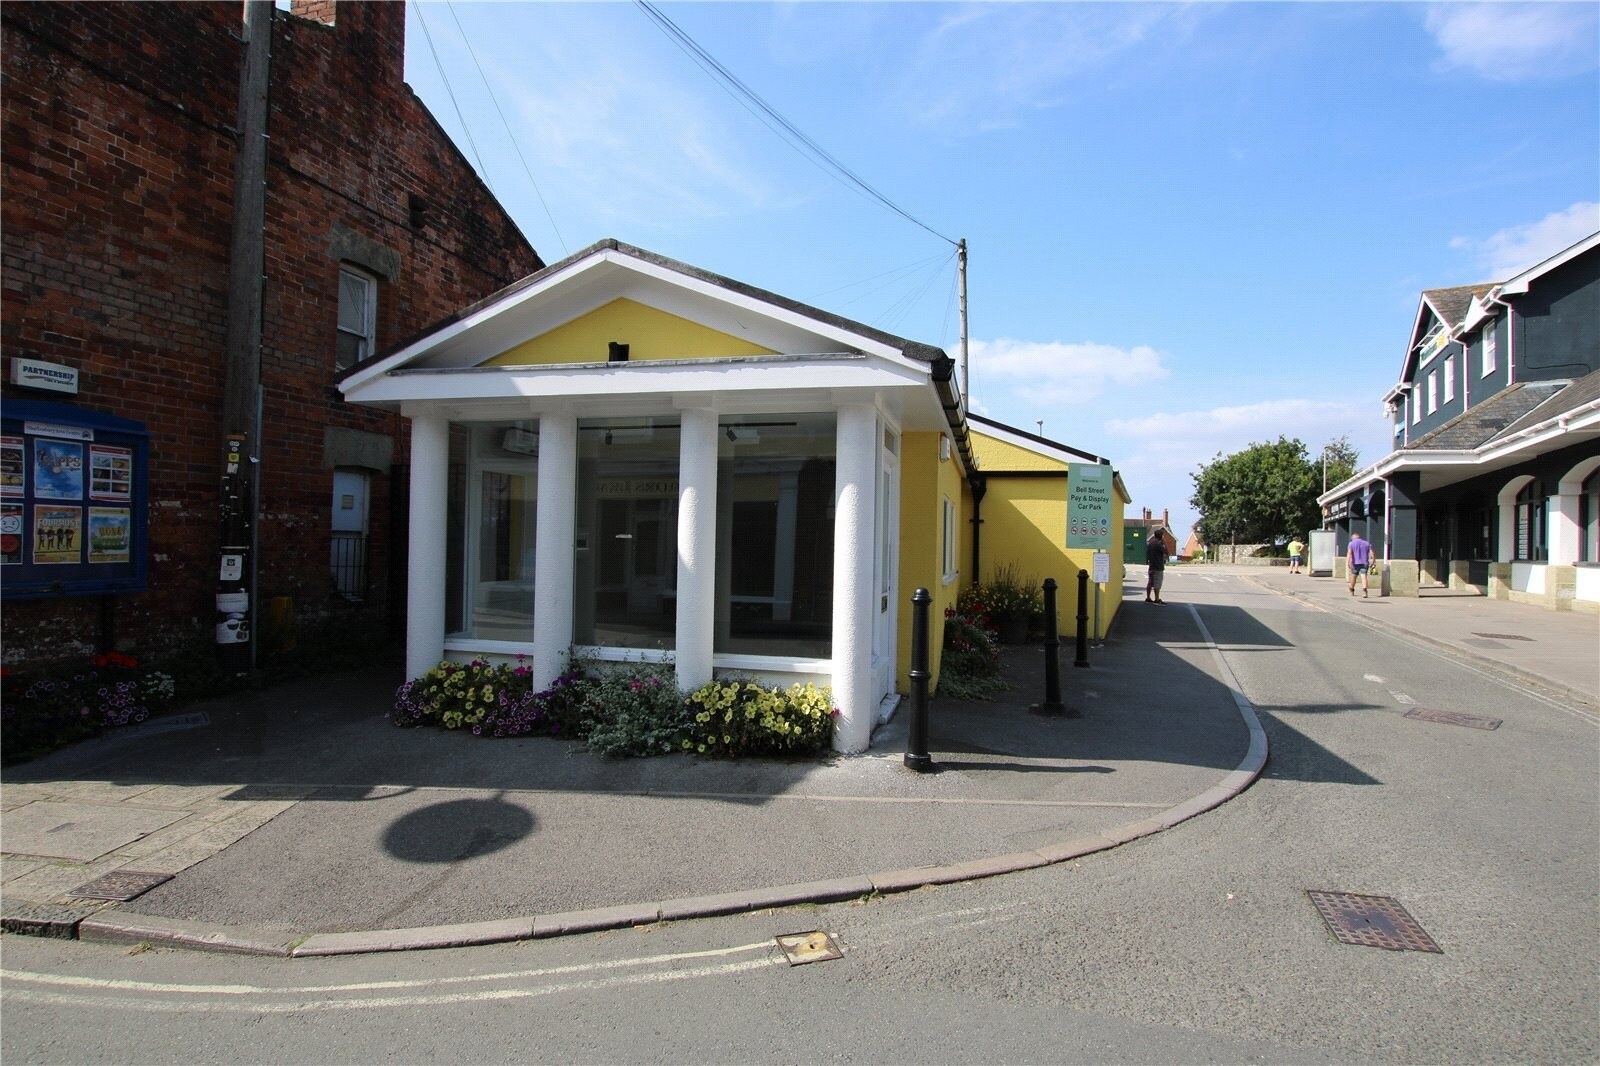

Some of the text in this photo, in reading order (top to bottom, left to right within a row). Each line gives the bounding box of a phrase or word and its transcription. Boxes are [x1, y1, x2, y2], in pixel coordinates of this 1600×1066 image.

[23, 366, 74, 379] PARTNERSHIP
[1071, 494, 1082, 502] Pay
[1088, 495, 1109, 503] Display
